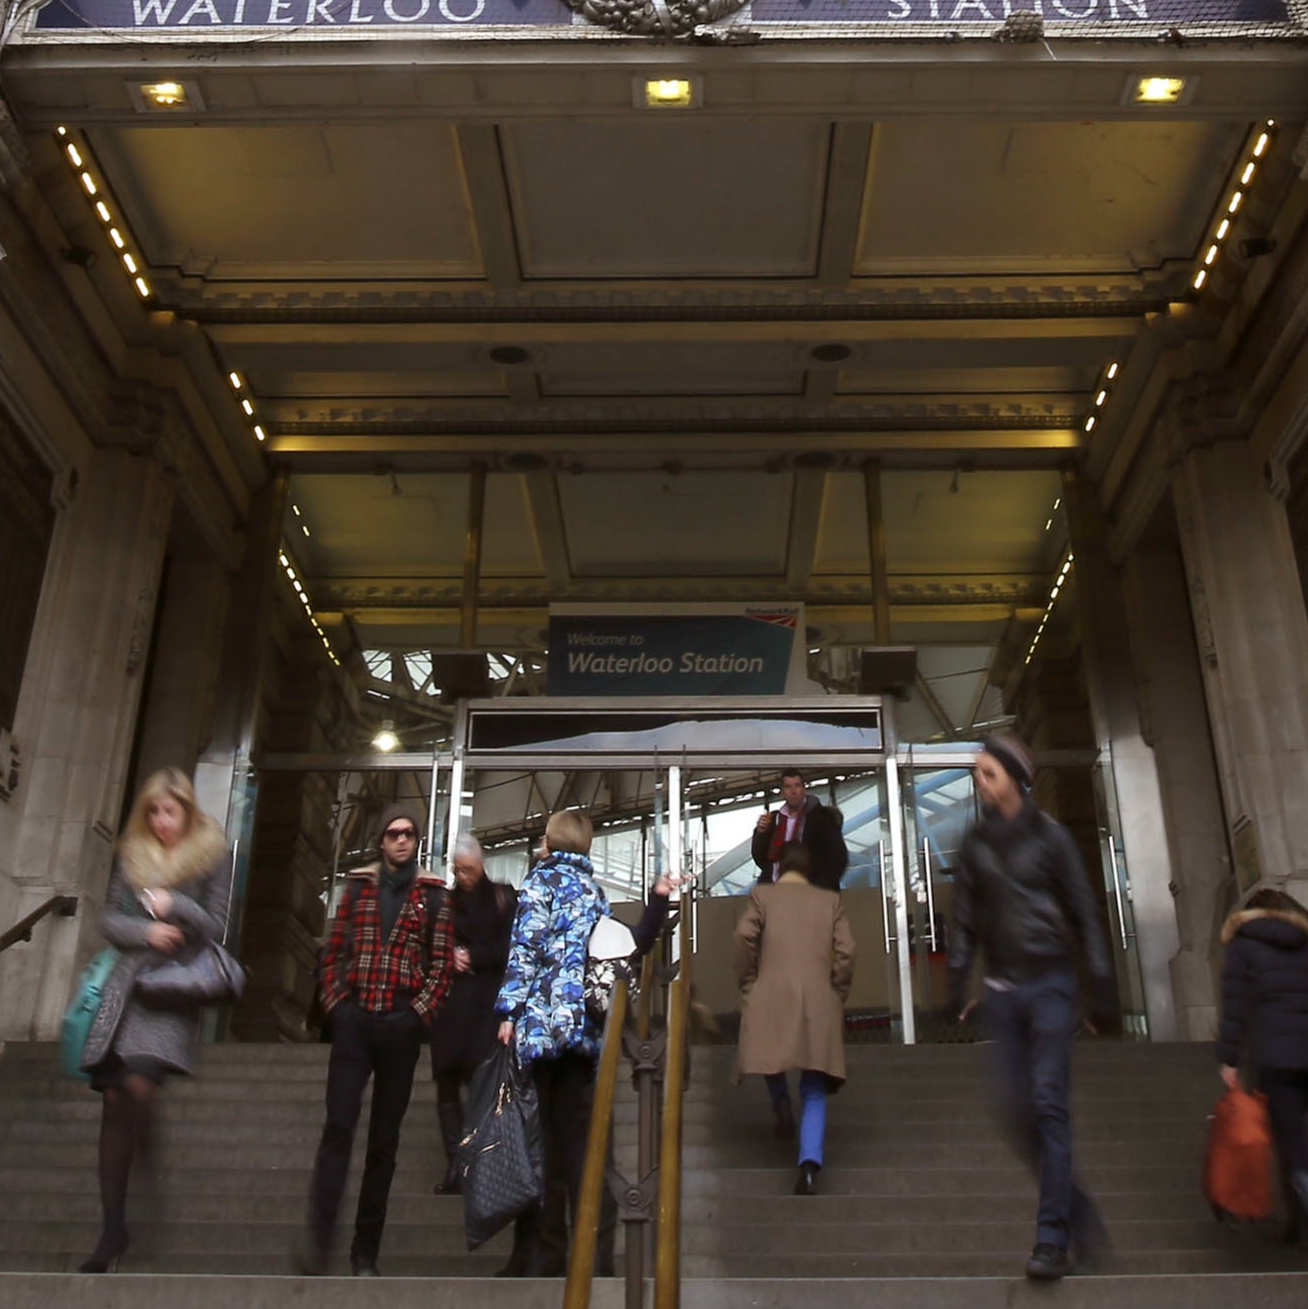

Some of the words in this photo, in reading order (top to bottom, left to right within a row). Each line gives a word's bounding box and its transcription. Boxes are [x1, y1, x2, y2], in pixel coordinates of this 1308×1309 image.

[567, 633, 626, 646] Welcome
[630, 633, 644, 646] to
[568, 652, 674, 673] Waterloo
[679, 652, 764, 673] Station
